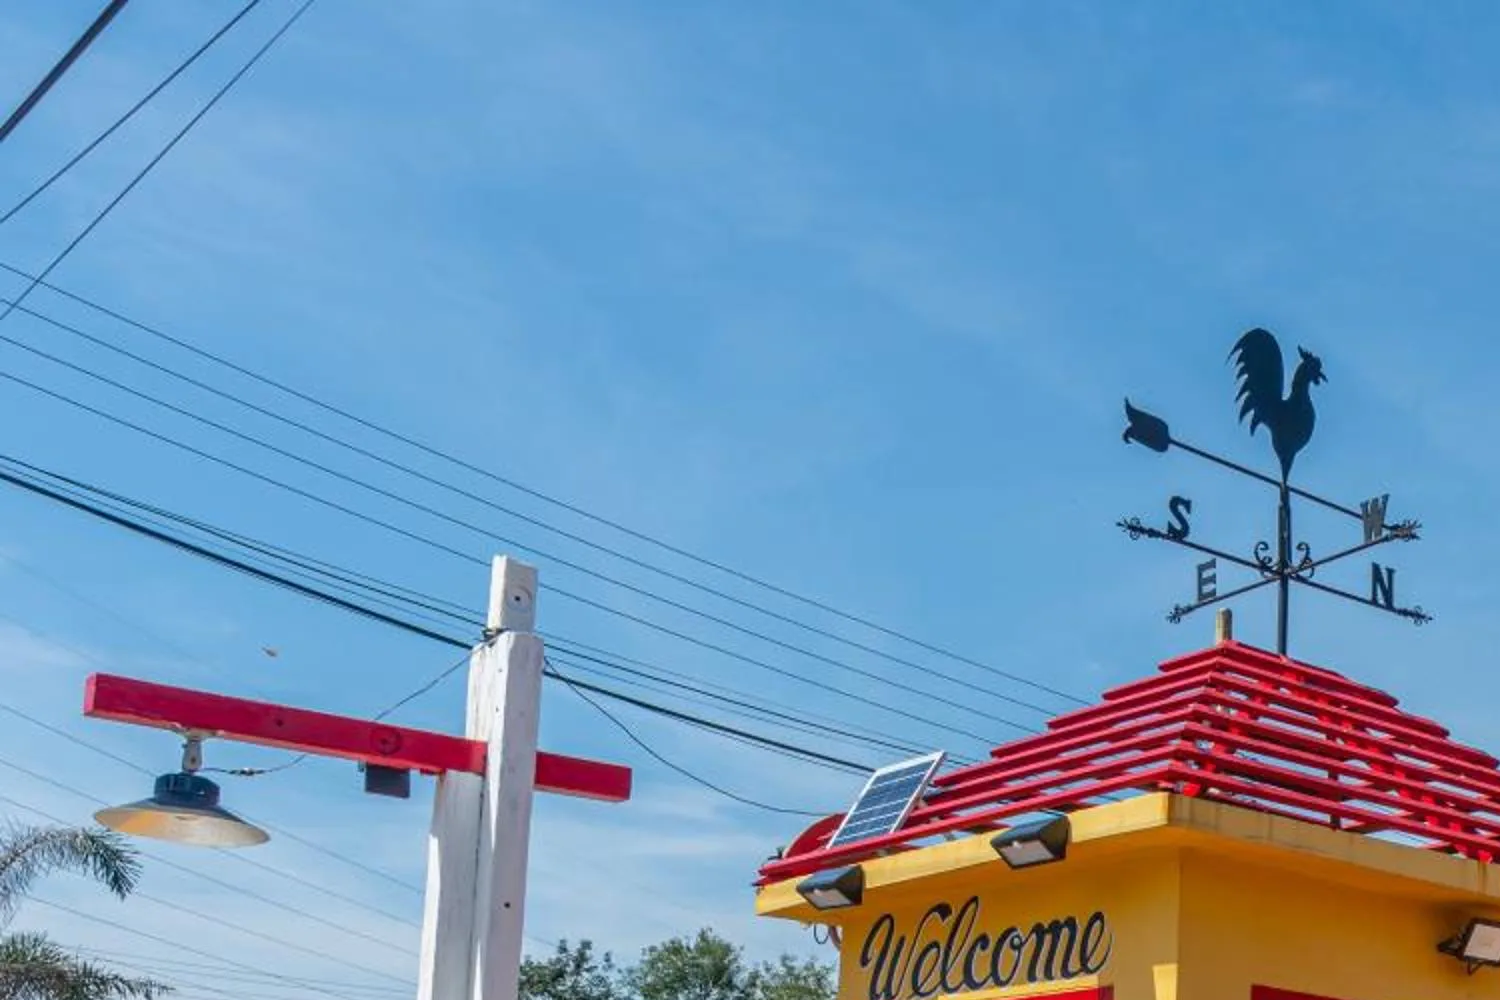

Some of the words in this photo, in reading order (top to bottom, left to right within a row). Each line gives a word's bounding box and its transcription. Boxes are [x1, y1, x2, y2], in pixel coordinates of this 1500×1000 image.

[1167, 495, 1191, 540] S
[1360, 494, 1389, 541] W
[1197, 558, 1217, 602] E
[1371, 562, 1396, 607] N
